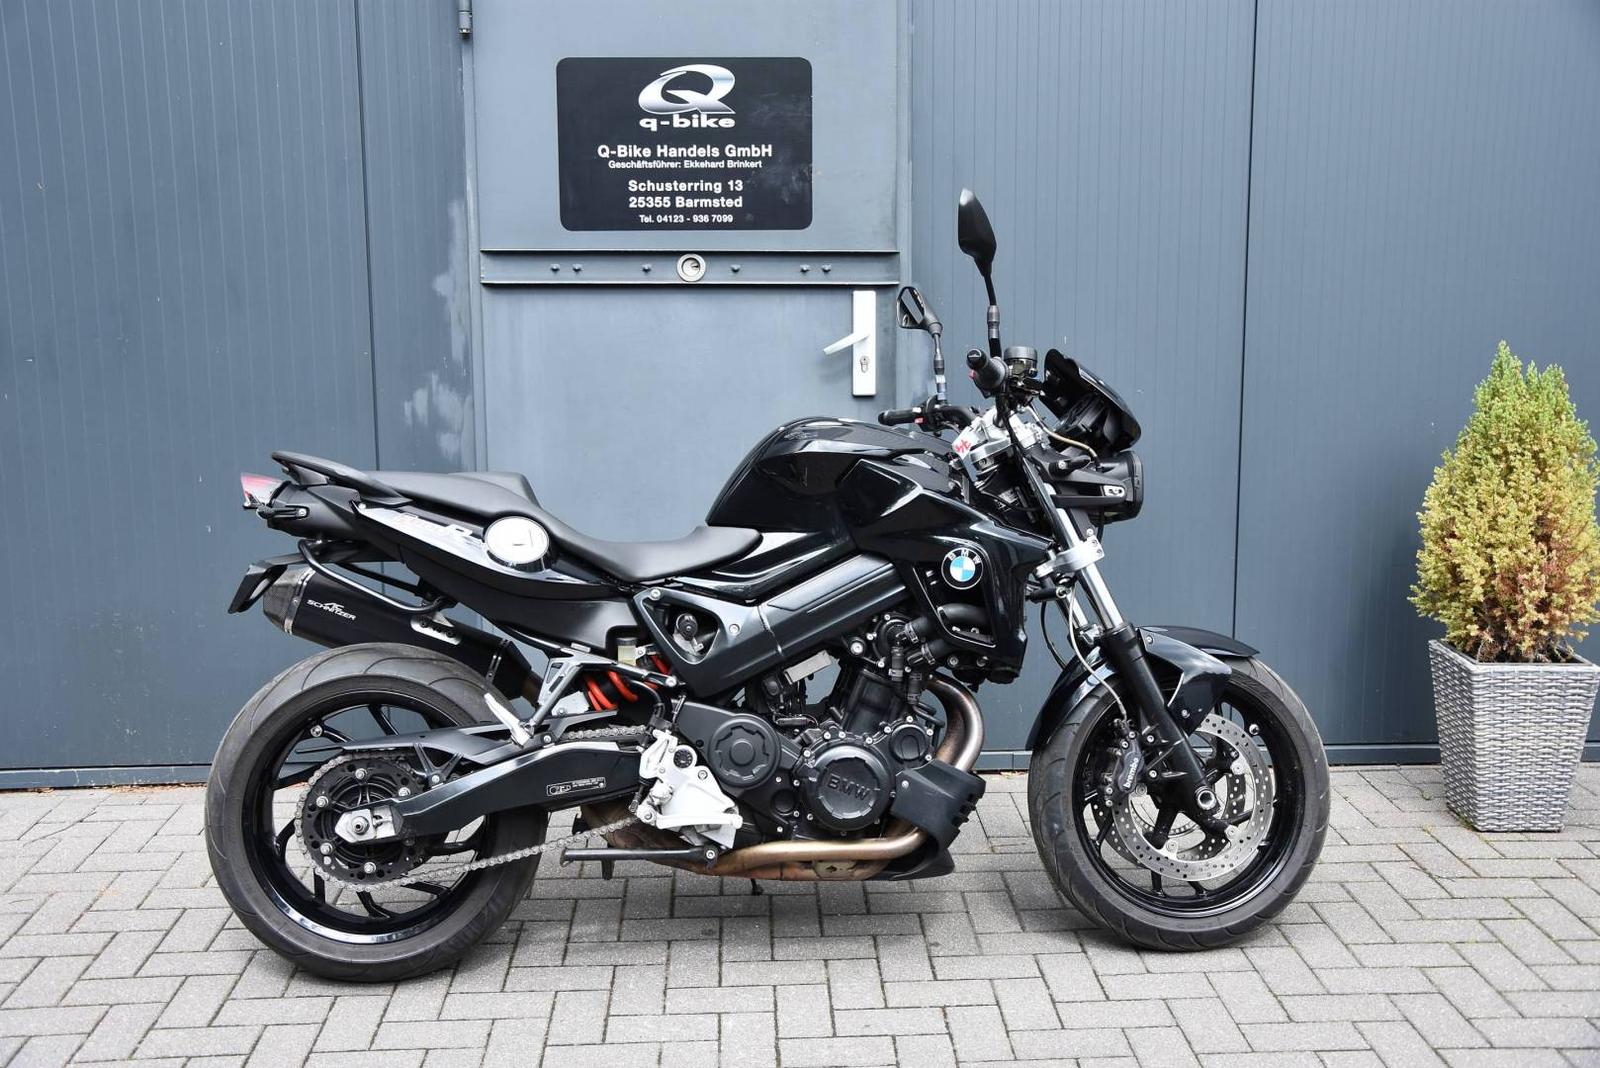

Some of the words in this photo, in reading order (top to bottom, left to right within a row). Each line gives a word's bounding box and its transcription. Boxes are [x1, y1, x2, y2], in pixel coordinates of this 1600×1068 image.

[638, 64, 736, 114] Q
[639, 113, 736, 131] q-bike
[597, 144, 652, 158] Q-Bike
[656, 144, 720, 157] Handels
[724, 144, 772, 157] GmbH
[608, 159, 682, 169] Geschäftsführer:
[683, 159, 725, 169] Ekkehard
[727, 159, 763, 169] Brinkert
[628, 179, 722, 194] Schusterring
[727, 179, 744, 191] 13
[628, 196, 671, 208] 25355
[675, 195, 743, 208] Barmsted
[639, 214, 655, 223] Tel.
[656, 214, 684, 223] 04123
[711, 213, 734, 223] 7099
[946, 548, 982, 564] BMW
[1123, 757, 1139, 788] brembo
[827, 773, 871, 800] BMW
